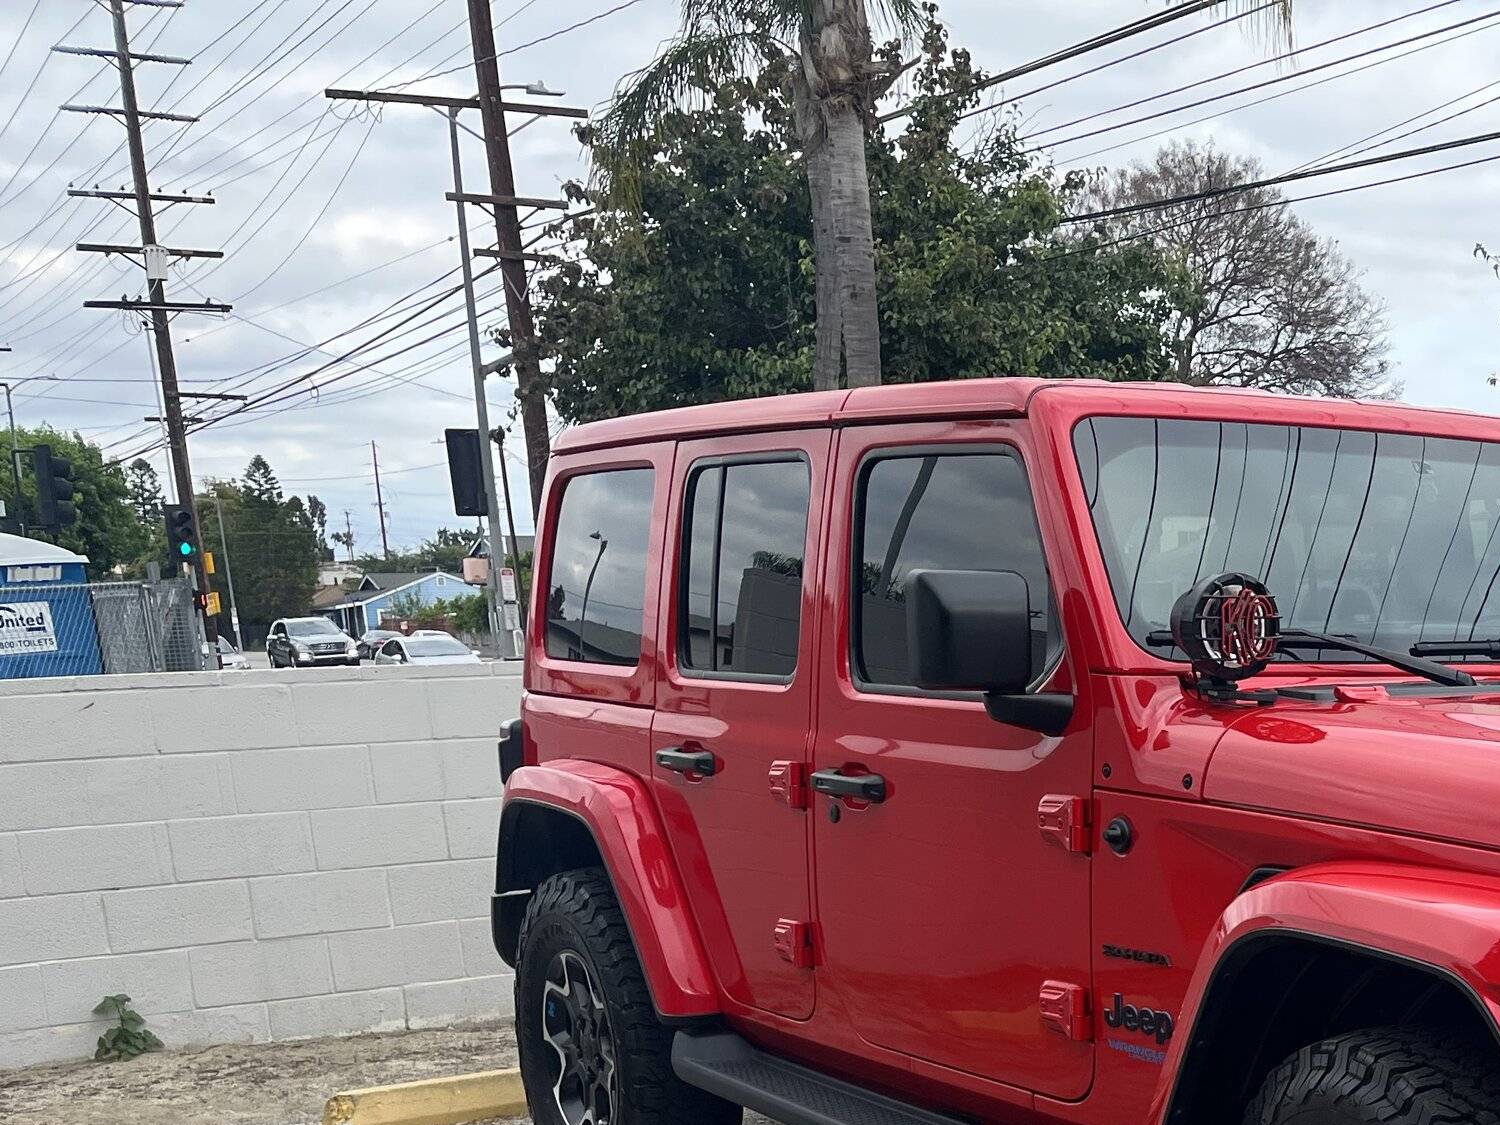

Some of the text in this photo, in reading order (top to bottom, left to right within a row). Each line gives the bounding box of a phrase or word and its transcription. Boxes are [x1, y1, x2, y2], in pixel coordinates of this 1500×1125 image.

[18, 638, 55, 648] TOILETS
[1222, 588, 1274, 666] KC
[1103, 992, 1174, 1046] Jeep
